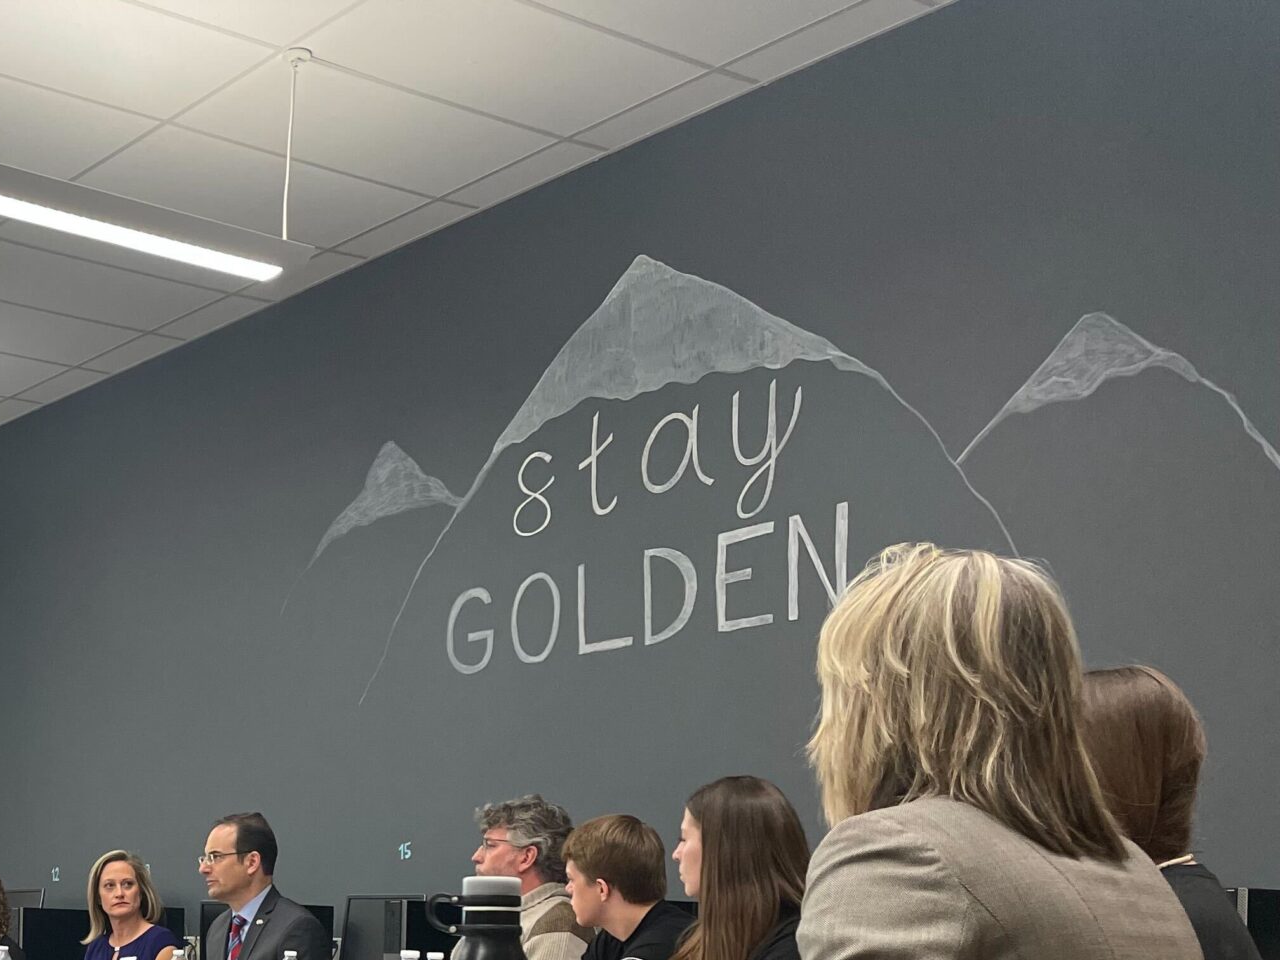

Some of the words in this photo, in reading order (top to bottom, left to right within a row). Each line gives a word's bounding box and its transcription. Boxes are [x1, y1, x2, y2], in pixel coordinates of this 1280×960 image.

[513, 379, 802, 536] stay
[447, 502, 848, 674] GOLDEN
[51, 866, 60, 881] 12
[399, 841, 412, 860] 15
